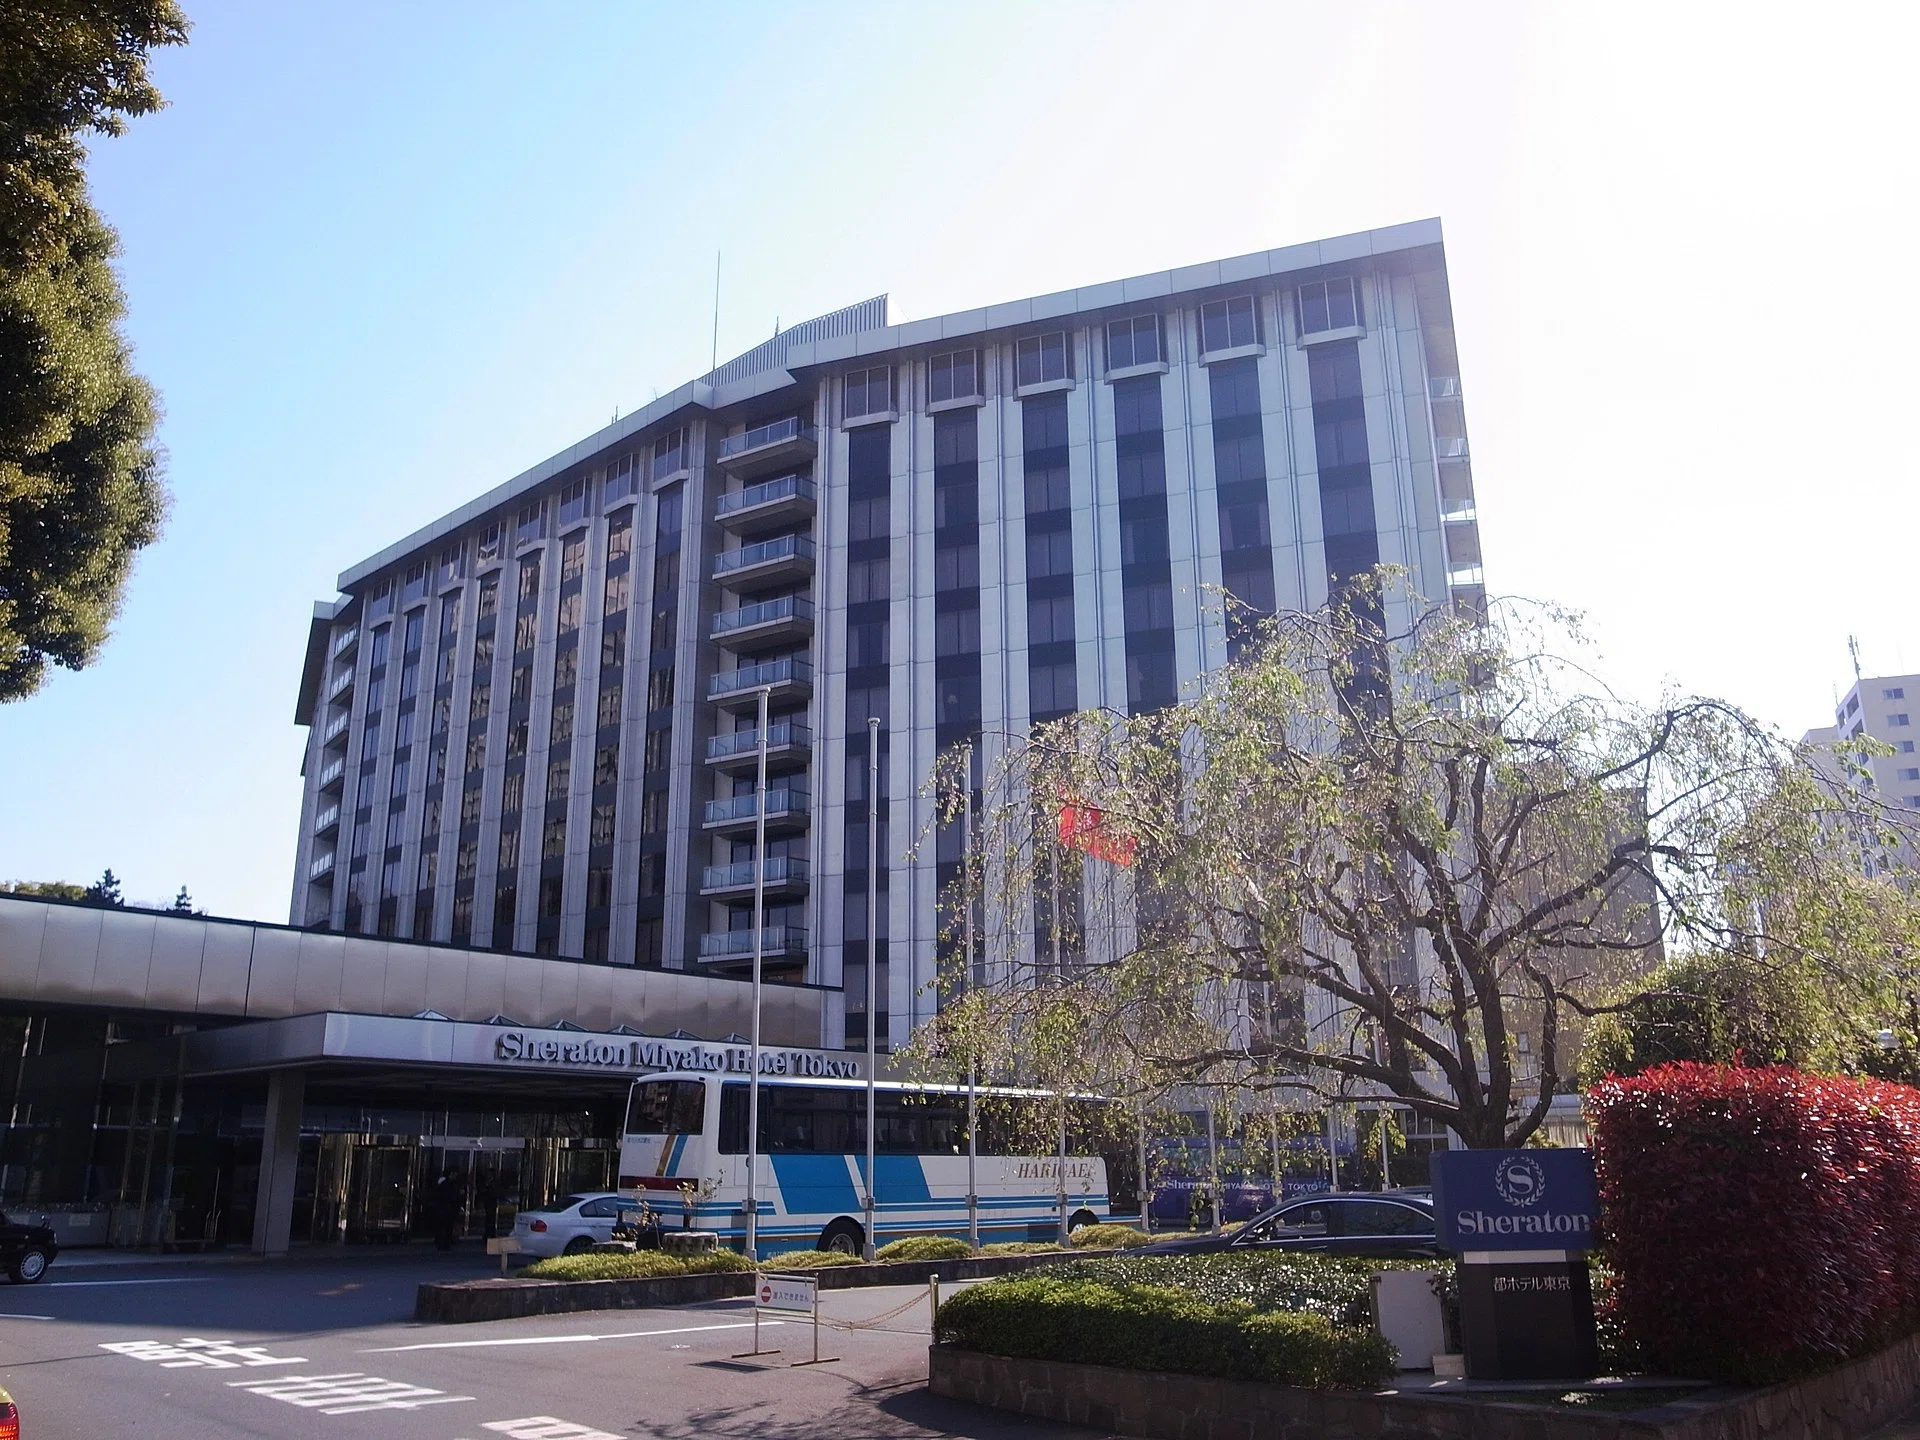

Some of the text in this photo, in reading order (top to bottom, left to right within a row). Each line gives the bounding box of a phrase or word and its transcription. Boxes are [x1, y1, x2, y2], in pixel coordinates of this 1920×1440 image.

[497, 1032, 631, 1065] Sheraton
[635, 1042, 728, 1073] Miyako
[795, 1053, 862, 1079] Tokyo
[1287, 1183, 1318, 1192] TOKYO
[1507, 1165, 1534, 1195] S
[1458, 1210, 1590, 1235] Sheraton
[1493, 1276, 1571, 1293] 都ホテル東京
